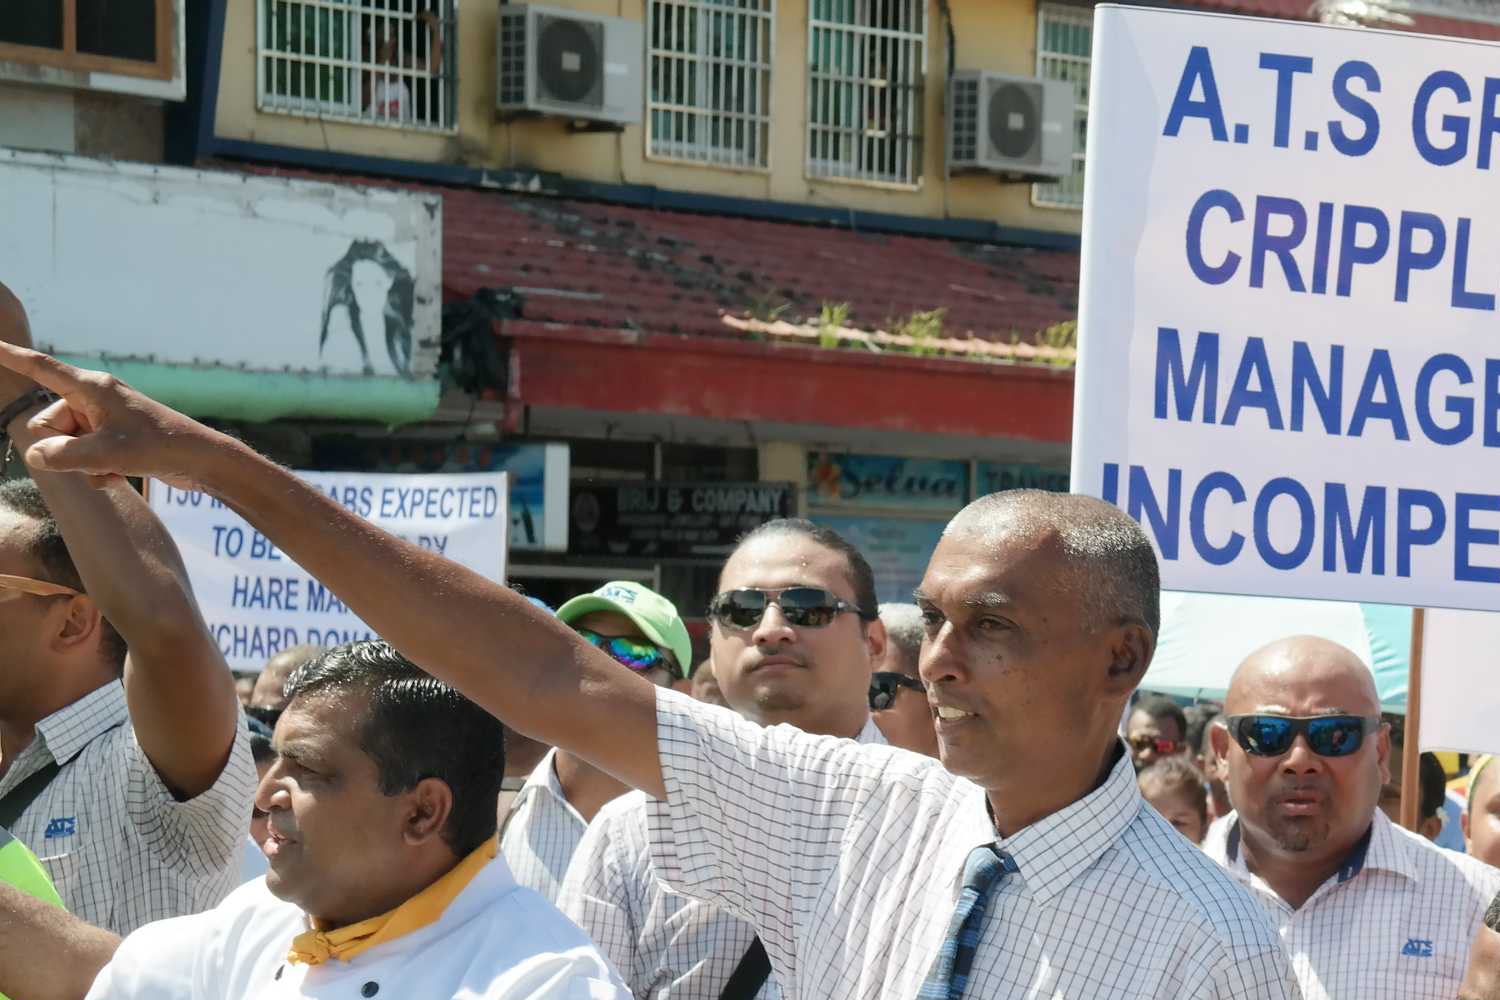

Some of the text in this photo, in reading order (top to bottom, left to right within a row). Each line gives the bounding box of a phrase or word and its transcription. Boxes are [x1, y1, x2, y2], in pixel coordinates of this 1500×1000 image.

[1163, 47, 1380, 157] A.T.S
[380, 486, 497, 519] EXPECTED
[691, 487, 784, 514] COMPANY
[213, 526, 244, 558] TO
[232, 576, 299, 610] HARE
[209, 624, 299, 660] CHARD
